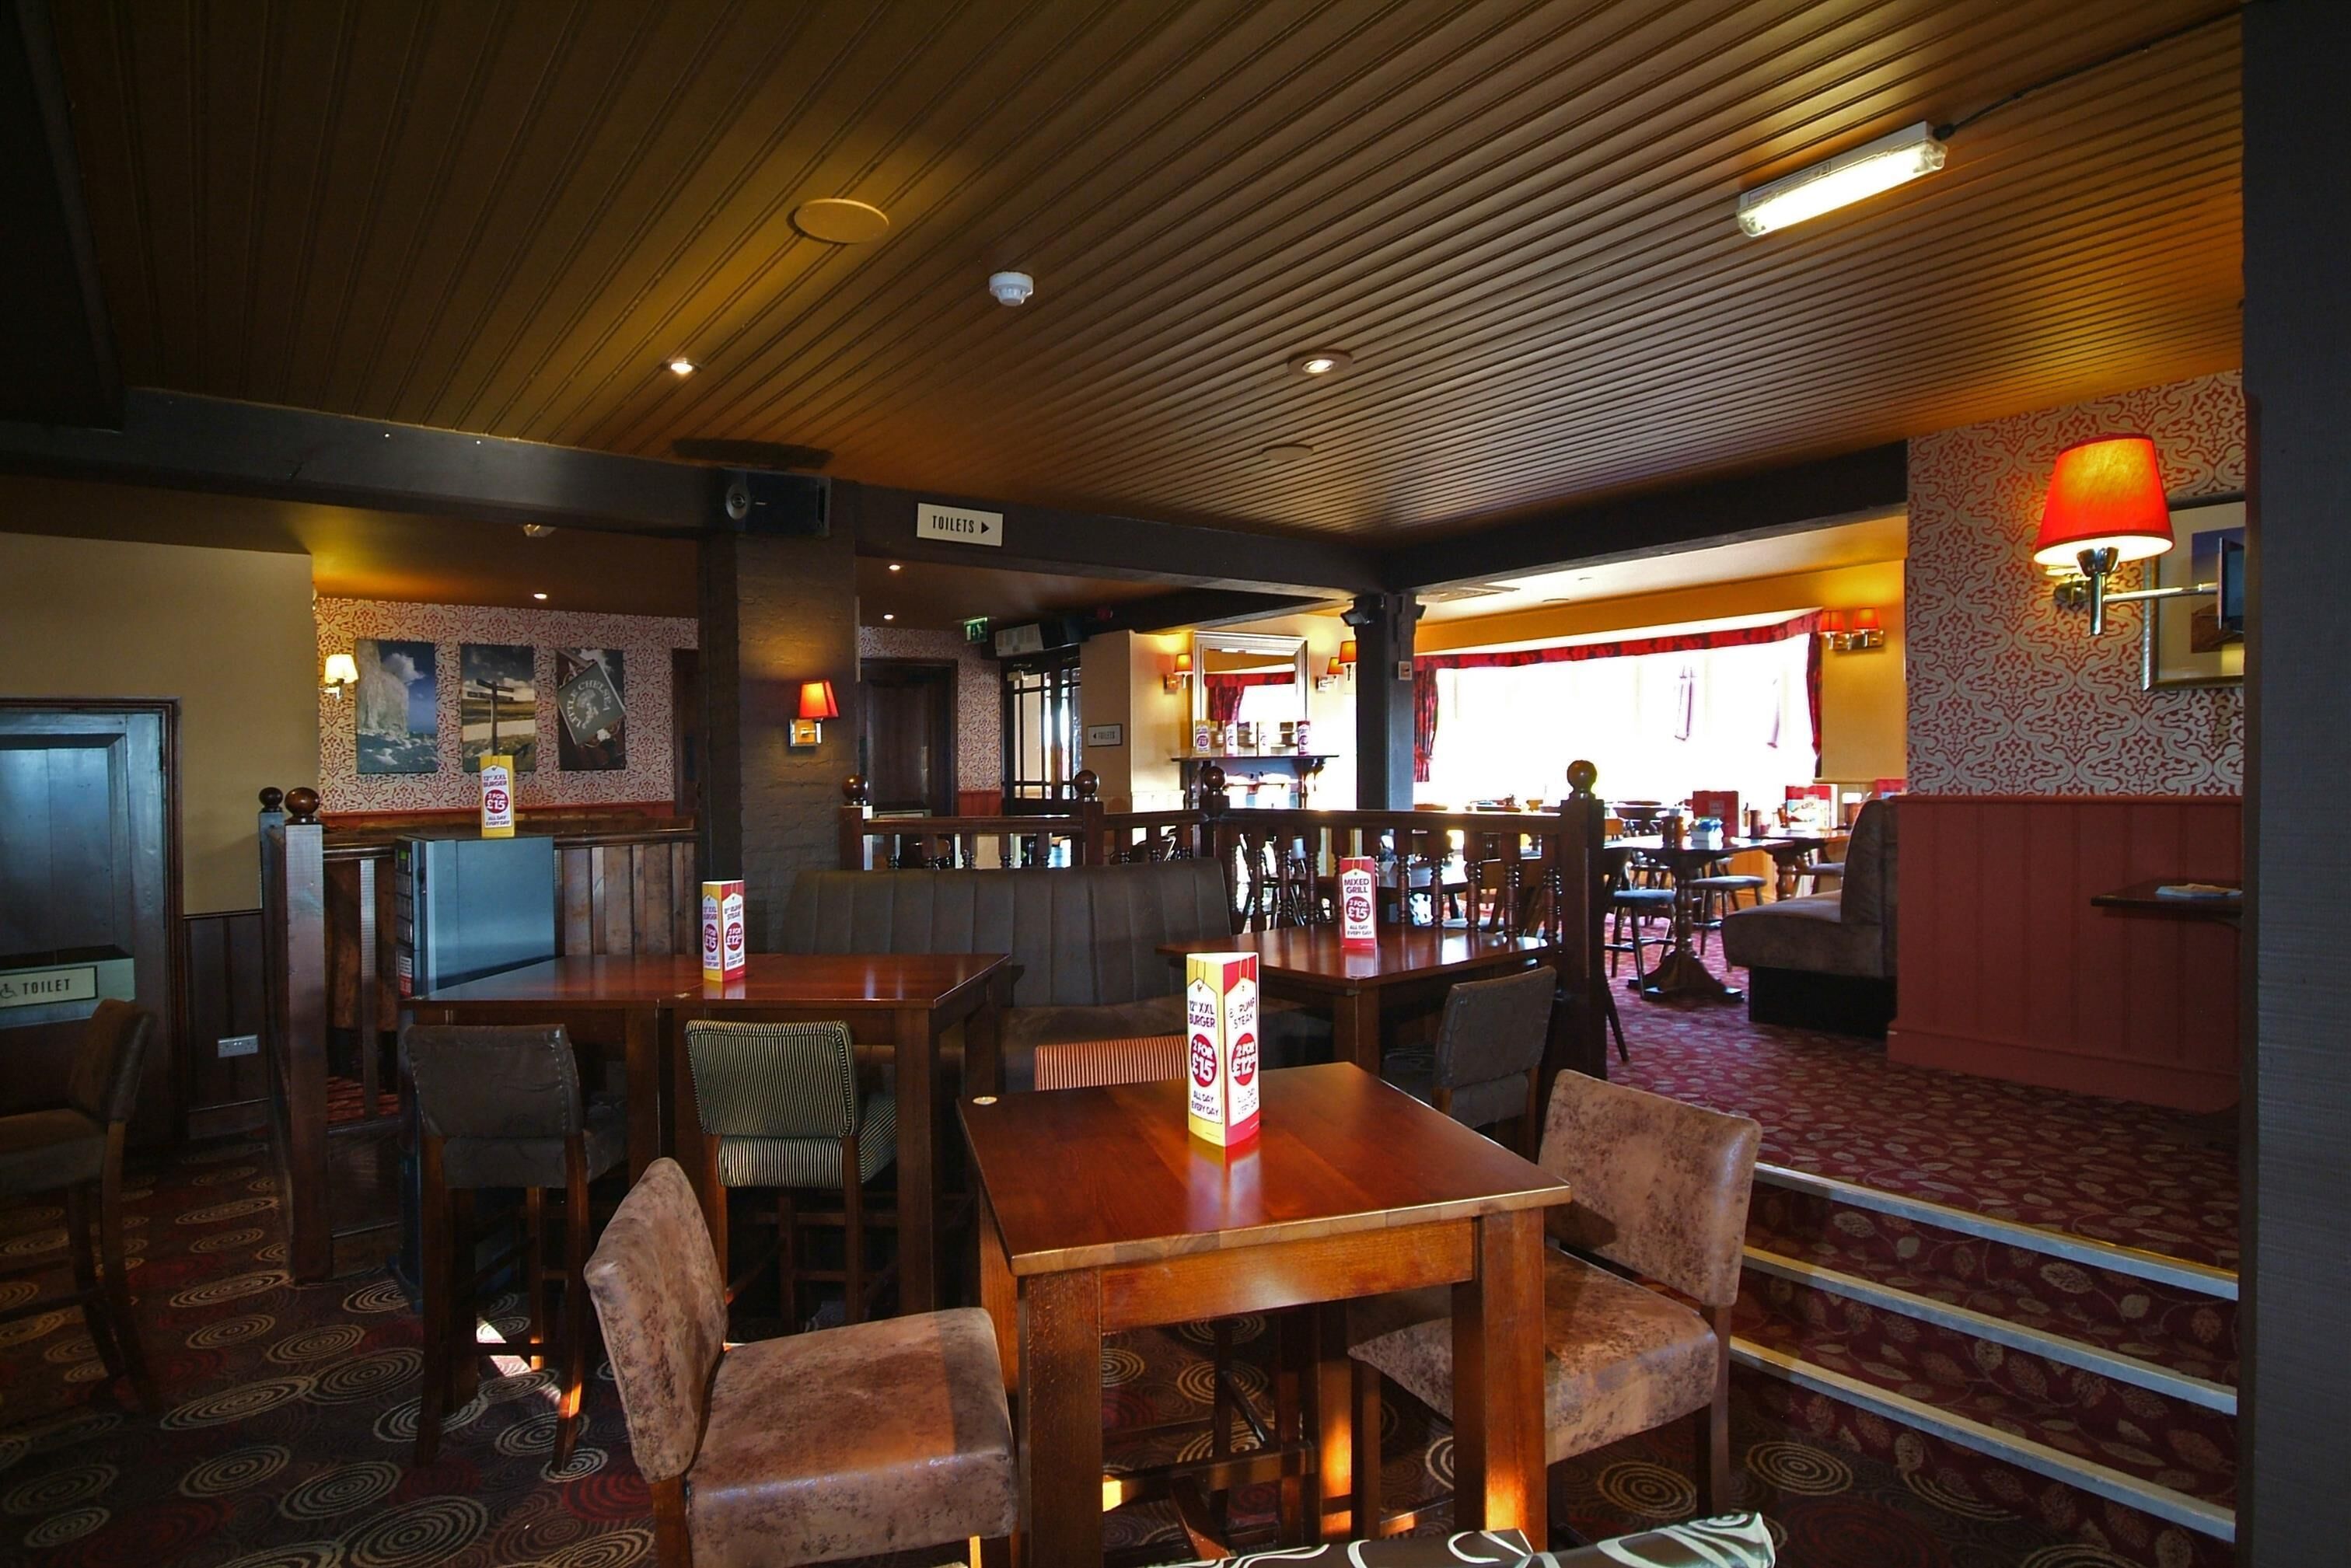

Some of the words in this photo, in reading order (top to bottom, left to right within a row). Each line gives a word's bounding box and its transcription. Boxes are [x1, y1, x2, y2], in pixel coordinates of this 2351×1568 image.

[932, 515, 975, 533] TOILETS
[567, 689, 582, 728] LITTLE
[578, 679, 611, 711] CHELSEA
[487, 799, 506, 809] £15
[1355, 899, 1368, 908] FOR
[1347, 906, 1369, 920] £15
[23, 978, 70, 996] TOILET
[1200, 1002, 1214, 1015] XXL
[1189, 1014, 1215, 1028] BURGER
[1233, 1011, 1253, 1029] STEAK
[1193, 1039, 1197, 1051] 2
[1198, 1042, 1214, 1060] FOR
[1236, 1044, 1242, 1056] 2
[1242, 1041, 1255, 1056] FOR
[1192, 1053, 1215, 1082] £15
[1202, 1094, 1214, 1102] DAY
[1191, 1100, 1205, 1112] EVERY
[1206, 1107, 1218, 1116] DAY
